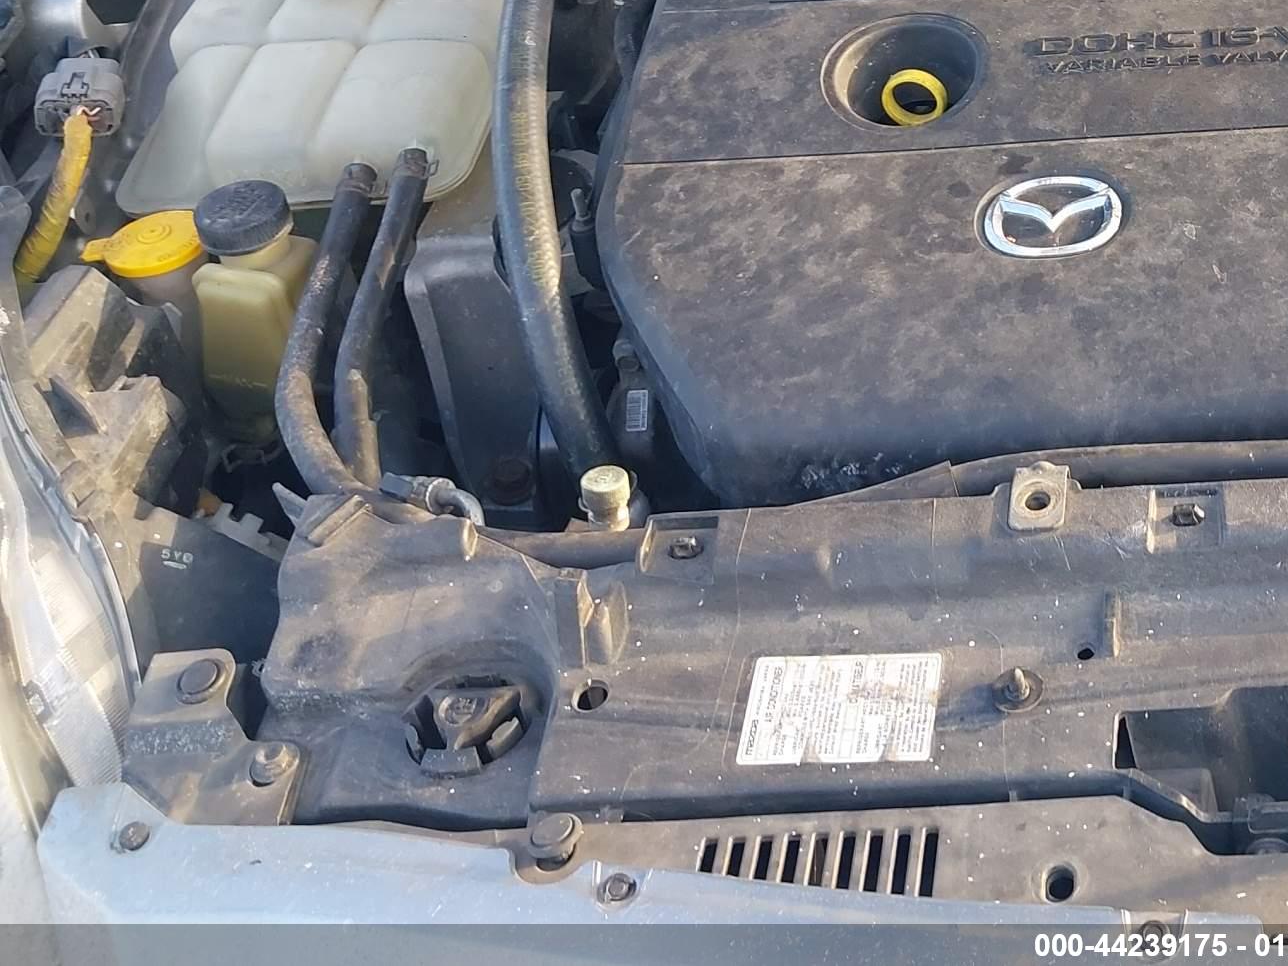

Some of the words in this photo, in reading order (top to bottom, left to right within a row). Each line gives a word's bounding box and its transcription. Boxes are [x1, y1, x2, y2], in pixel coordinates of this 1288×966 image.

[1030, 28, 1197, 57] DOHC
[1046, 53, 1202, 74] VARIABLE
[744, 718, 760, 757] mazda
